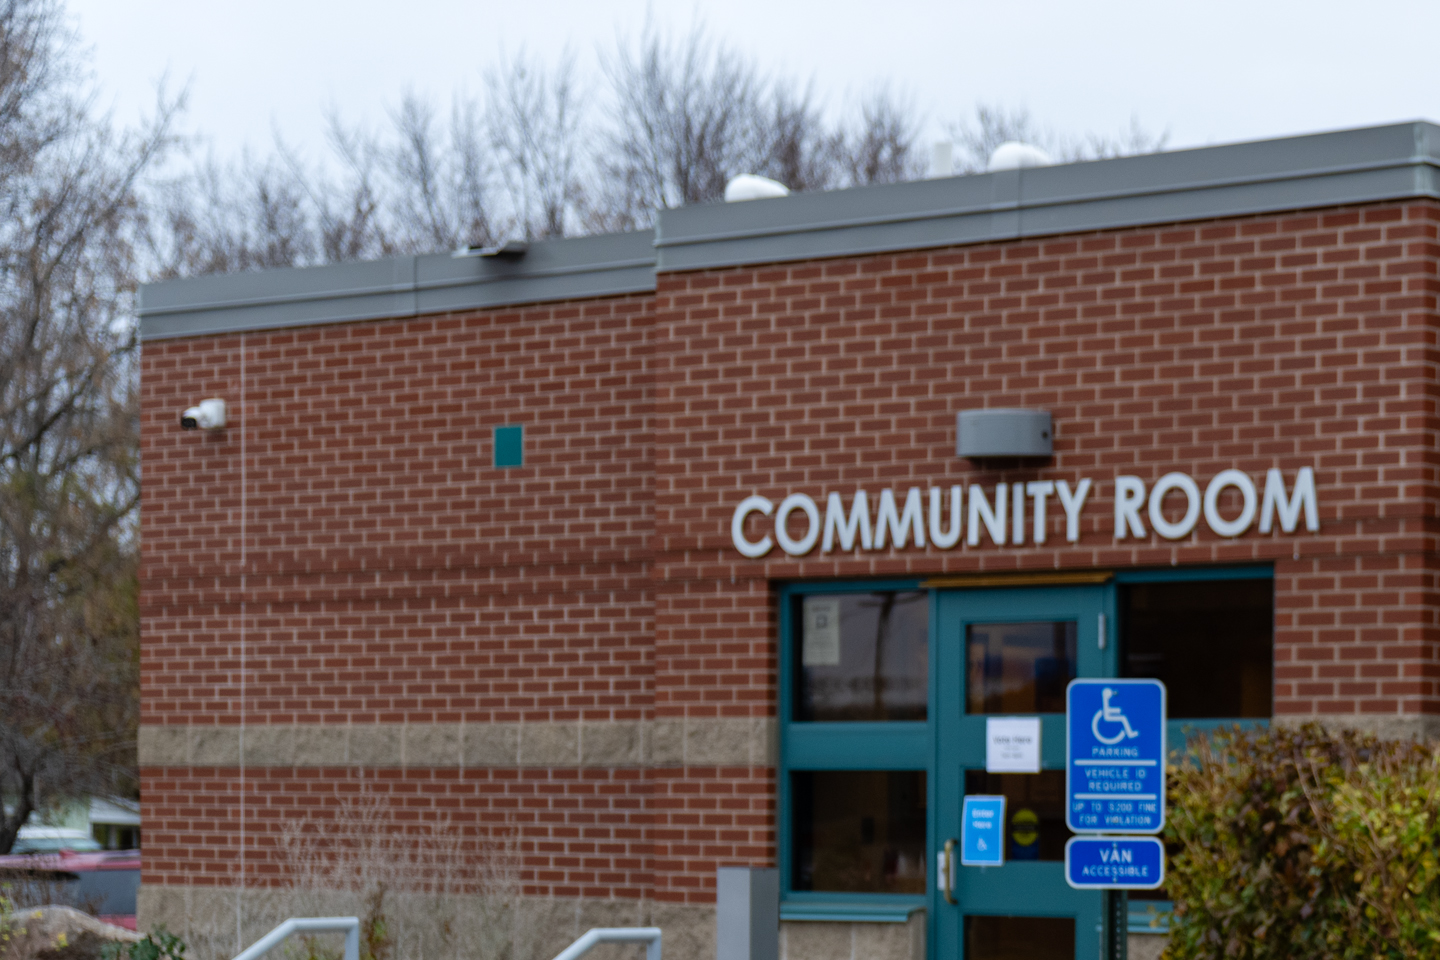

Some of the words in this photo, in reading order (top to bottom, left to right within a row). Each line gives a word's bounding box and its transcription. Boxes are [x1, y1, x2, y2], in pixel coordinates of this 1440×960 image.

[731, 477, 1093, 558] COMMUNITY
[1115, 466, 1320, 540] ROOM
[1092, 746, 1138, 757] PARKING
[1085, 768, 1129, 779] VEHICLE
[1135, 768, 1146, 779] ID
[1089, 781, 1142, 792] REQUIRED
[1072, 802, 1085, 813] UP
[1091, 802, 1102, 813] TO
[1138, 802, 1157, 813] FINE
[1079, 815, 1098, 825] FOR
[1104, 815, 1151, 826] VIOLATION
[1099, 848, 1132, 864] VAN
[1082, 865, 1149, 877] ACCESSIBLE
